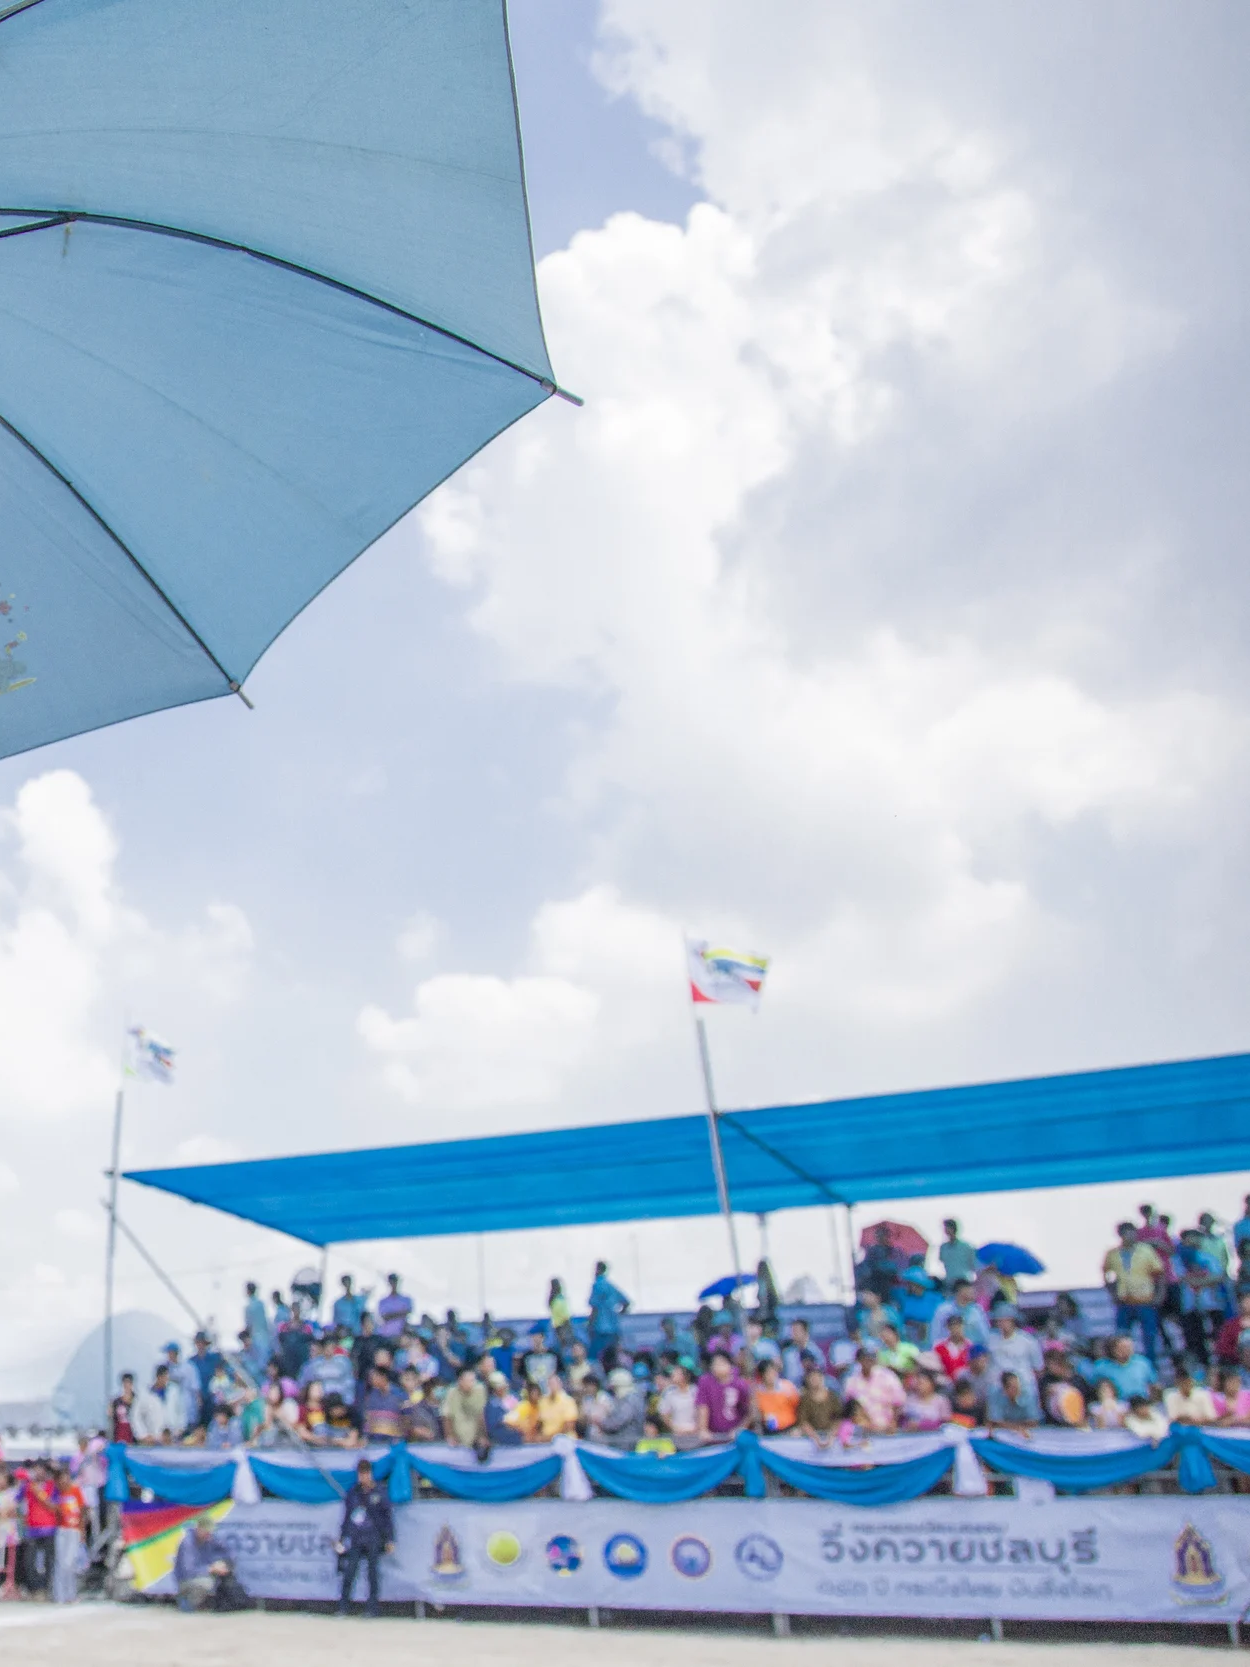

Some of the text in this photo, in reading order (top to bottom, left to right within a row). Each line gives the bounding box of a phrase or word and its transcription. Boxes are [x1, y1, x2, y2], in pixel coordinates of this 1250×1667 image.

[818, 1520, 1100, 1575] วิ่งควายชลบุรี
